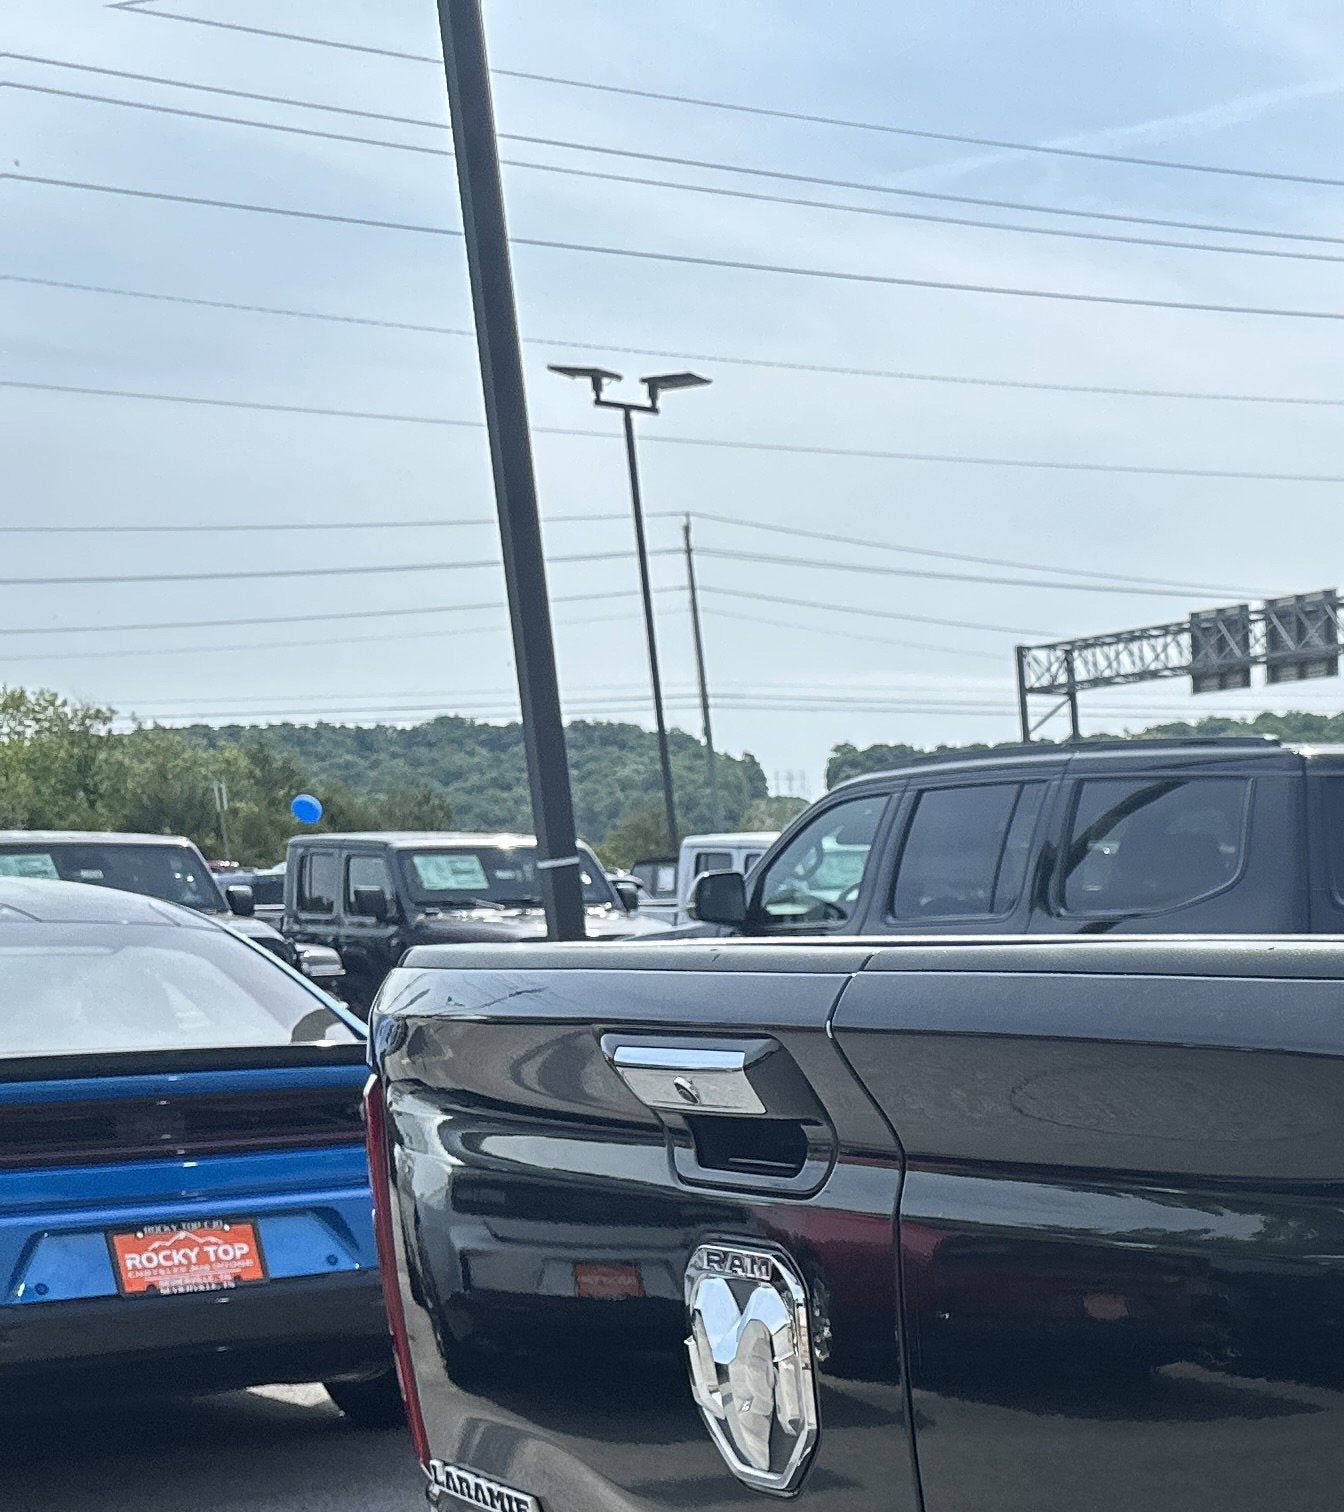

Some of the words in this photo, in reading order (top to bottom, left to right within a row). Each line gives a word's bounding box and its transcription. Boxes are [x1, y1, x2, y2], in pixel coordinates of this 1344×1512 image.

[124, 1247, 200, 1270] ROCKY
[203, 1242, 250, 1262] TOP
[702, 1248, 773, 1281] RAM
